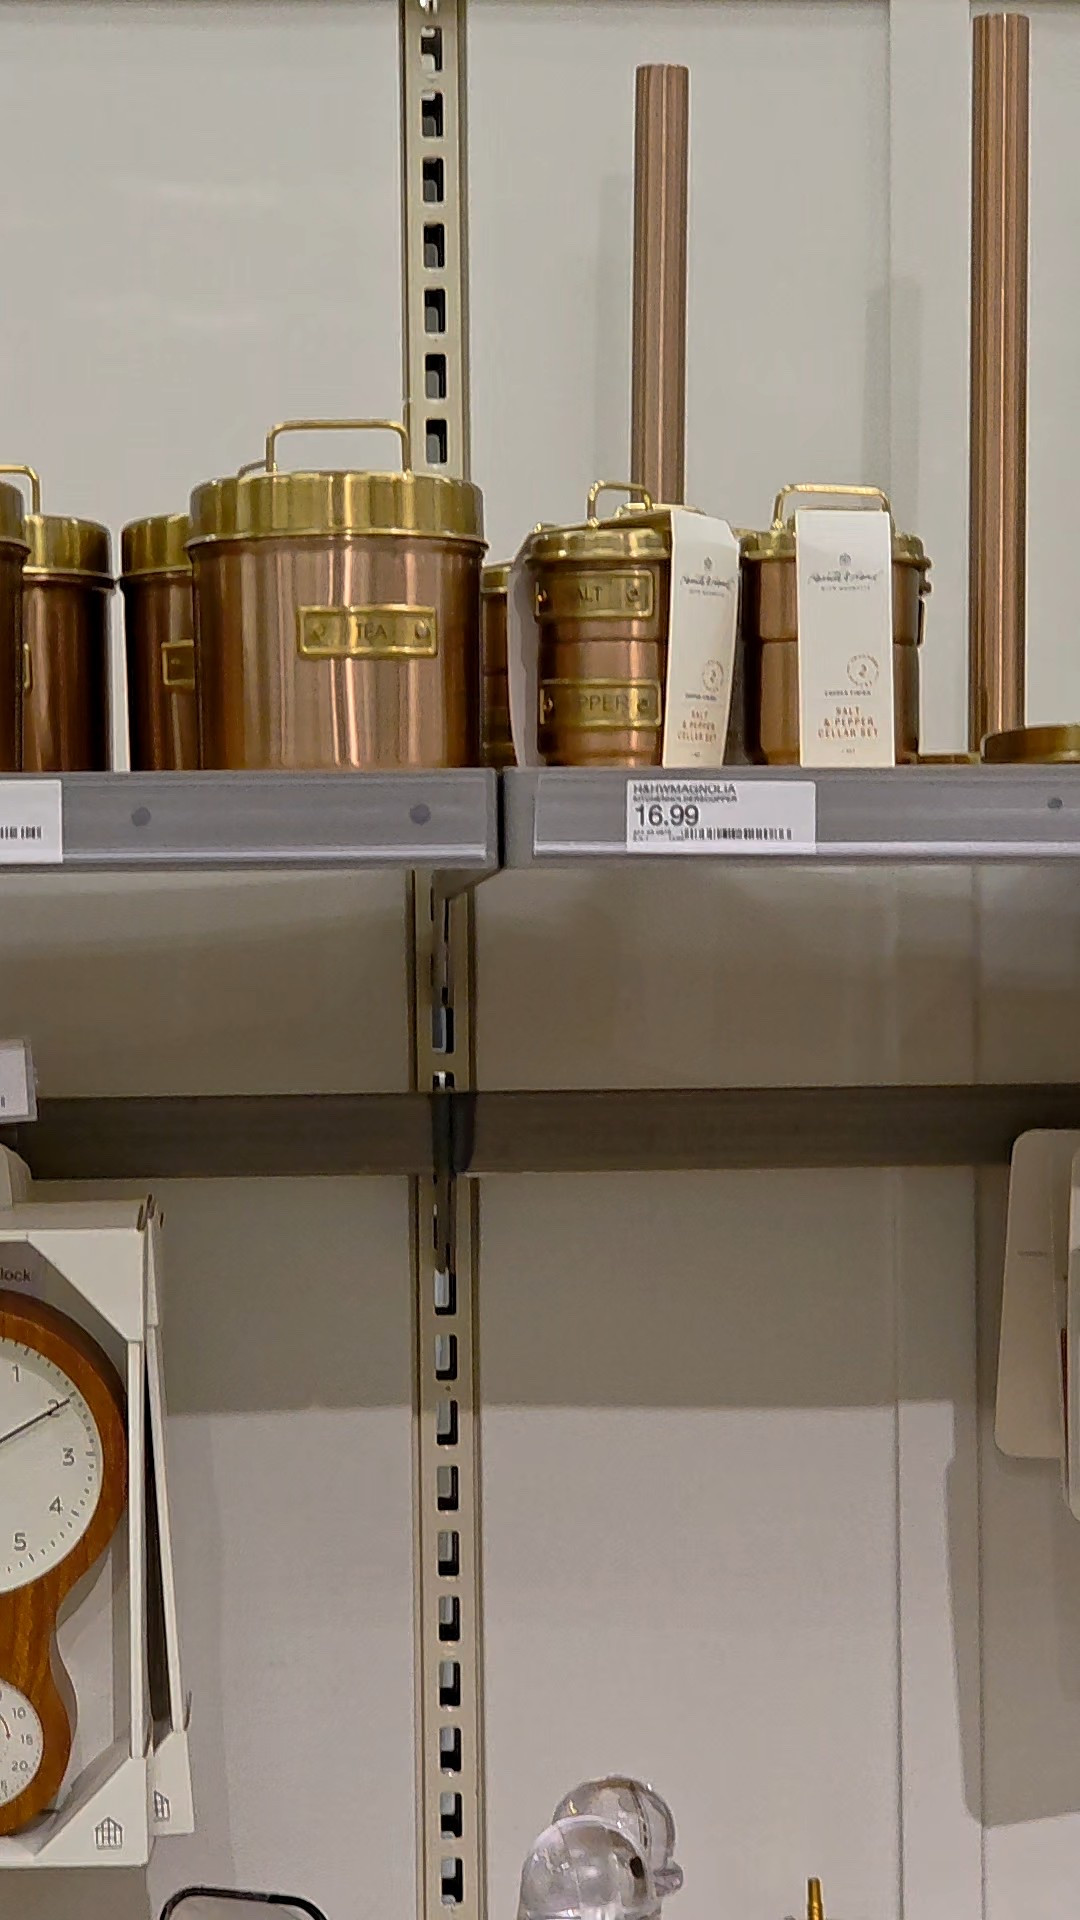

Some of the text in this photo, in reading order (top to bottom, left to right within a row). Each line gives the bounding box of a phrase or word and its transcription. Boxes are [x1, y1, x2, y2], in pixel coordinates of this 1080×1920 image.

[354, 622, 388, 642] TEA
[635, 804, 699, 826] 16.99
[12, 1364, 20, 1383] 1
[62, 1447, 75, 1466] 3
[49, 1496, 63, 1515] 4
[14, 1532, 27, 1551] 5
[12, 1707, 26, 1720] 10
[11, 1760, 29, 1772] 20
